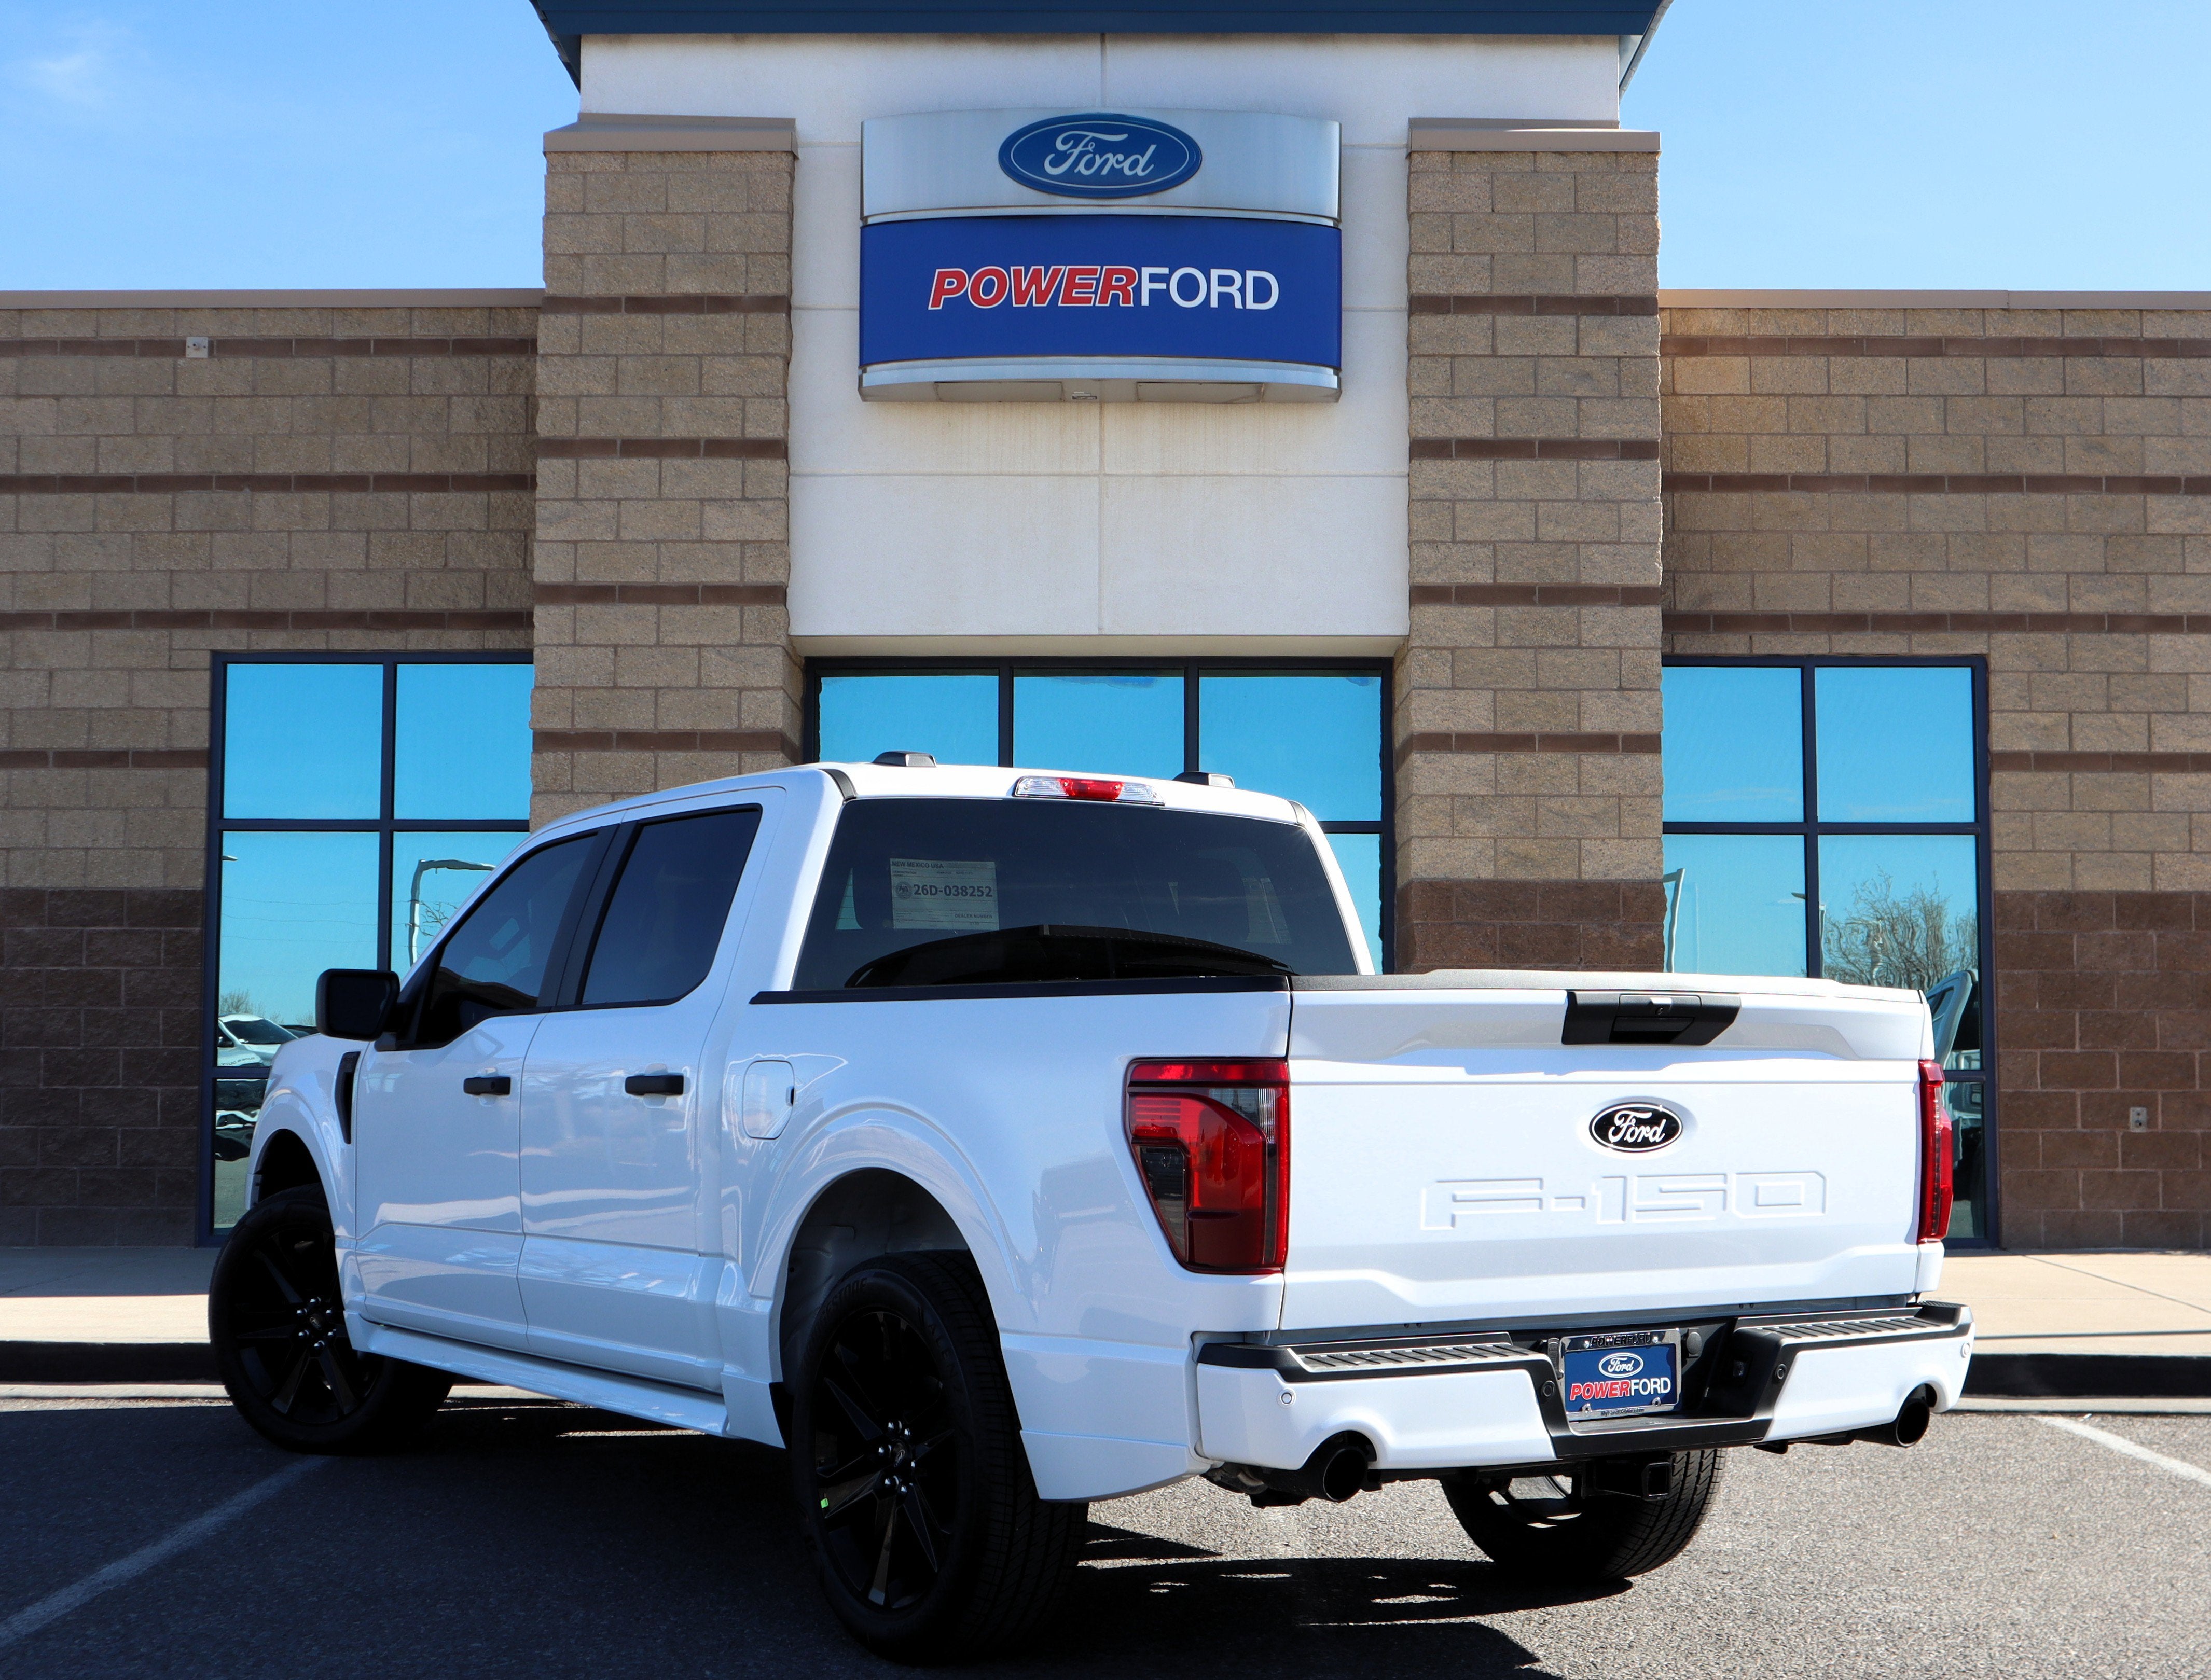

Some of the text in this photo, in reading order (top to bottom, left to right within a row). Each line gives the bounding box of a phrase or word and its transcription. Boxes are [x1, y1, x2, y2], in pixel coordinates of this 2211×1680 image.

[1044, 130, 1154, 176] Ford
[928, 265, 1280, 310] POWERFORD
[914, 884, 993, 897] 26D-038252
[1608, 1109, 1666, 1144] Ford
[1421, 1171, 1827, 1230] F-150
[1591, 1332, 1652, 1348] POWERFORD
[1608, 1357, 1635, 1372] Ford
[1570, 1377, 1671, 1401] POWERFORD
